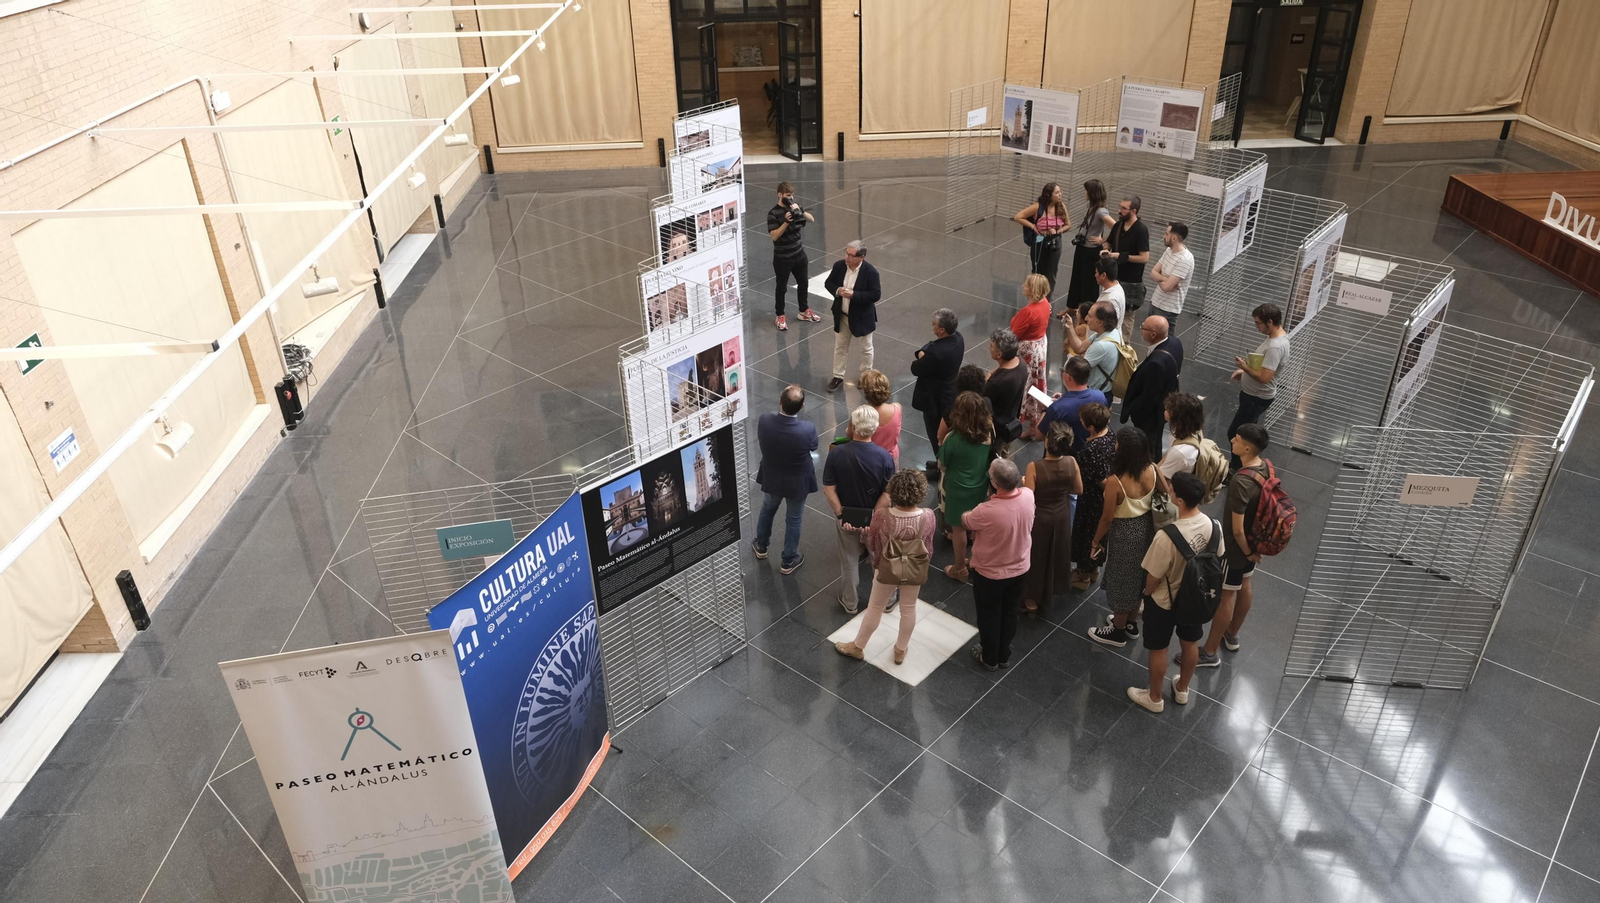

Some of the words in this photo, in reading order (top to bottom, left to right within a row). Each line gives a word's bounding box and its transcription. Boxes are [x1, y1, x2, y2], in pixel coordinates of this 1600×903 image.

[448, 535, 473, 543] INICIO
[449, 538, 494, 549] EXPOSICIÓN
[478, 543, 547, 614] CULTURA
[546, 521, 576, 557] UAL
[597, 558, 616, 573] Paseo
[615, 542, 651, 564] Matemático
[484, 589, 519, 623] UNIVERSIDAD
[518, 584, 528, 594] DE
[526, 564, 549, 589] ALMERÍA
[385, 648, 447, 666] DESQBRE
[520, 626, 570, 713] LUMINE
[298, 668, 325, 678] FECYT
[514, 722, 527, 749] IN
[275, 773, 337, 790] PASEO
[344, 747, 473, 778] MATEMÁTICO
[330, 768, 429, 793] AL-ÁNDALUS
[529, 838, 542, 854] 950
[541, 826, 552, 839] 015
